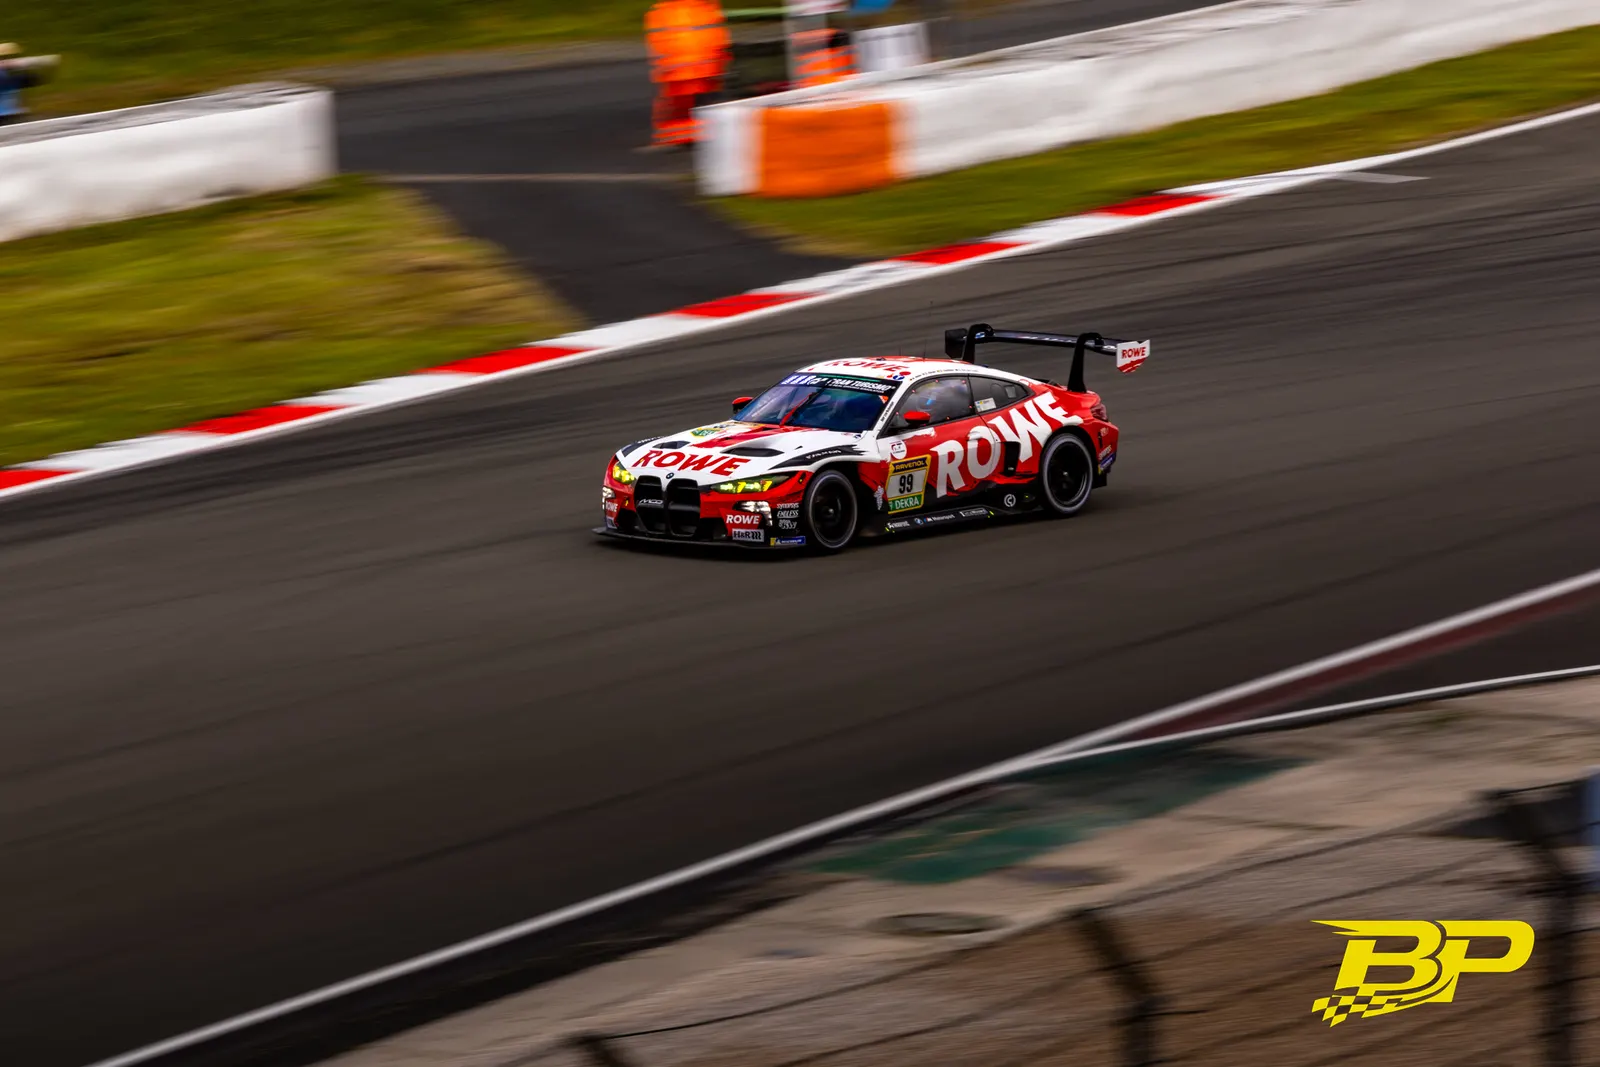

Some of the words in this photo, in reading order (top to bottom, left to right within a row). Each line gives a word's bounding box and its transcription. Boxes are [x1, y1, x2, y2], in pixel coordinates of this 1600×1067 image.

[1121, 347, 1147, 359] ROWE
[824, 360, 909, 372] ROWE
[930, 391, 1084, 498] ROWE
[632, 450, 751, 476] ROWE
[895, 460, 925, 472] RAVENOL
[898, 474, 913, 494] 99
[894, 496, 920, 510] DEKRA
[726, 514, 760, 525] ROWE
[733, 530, 750, 540] H&R
